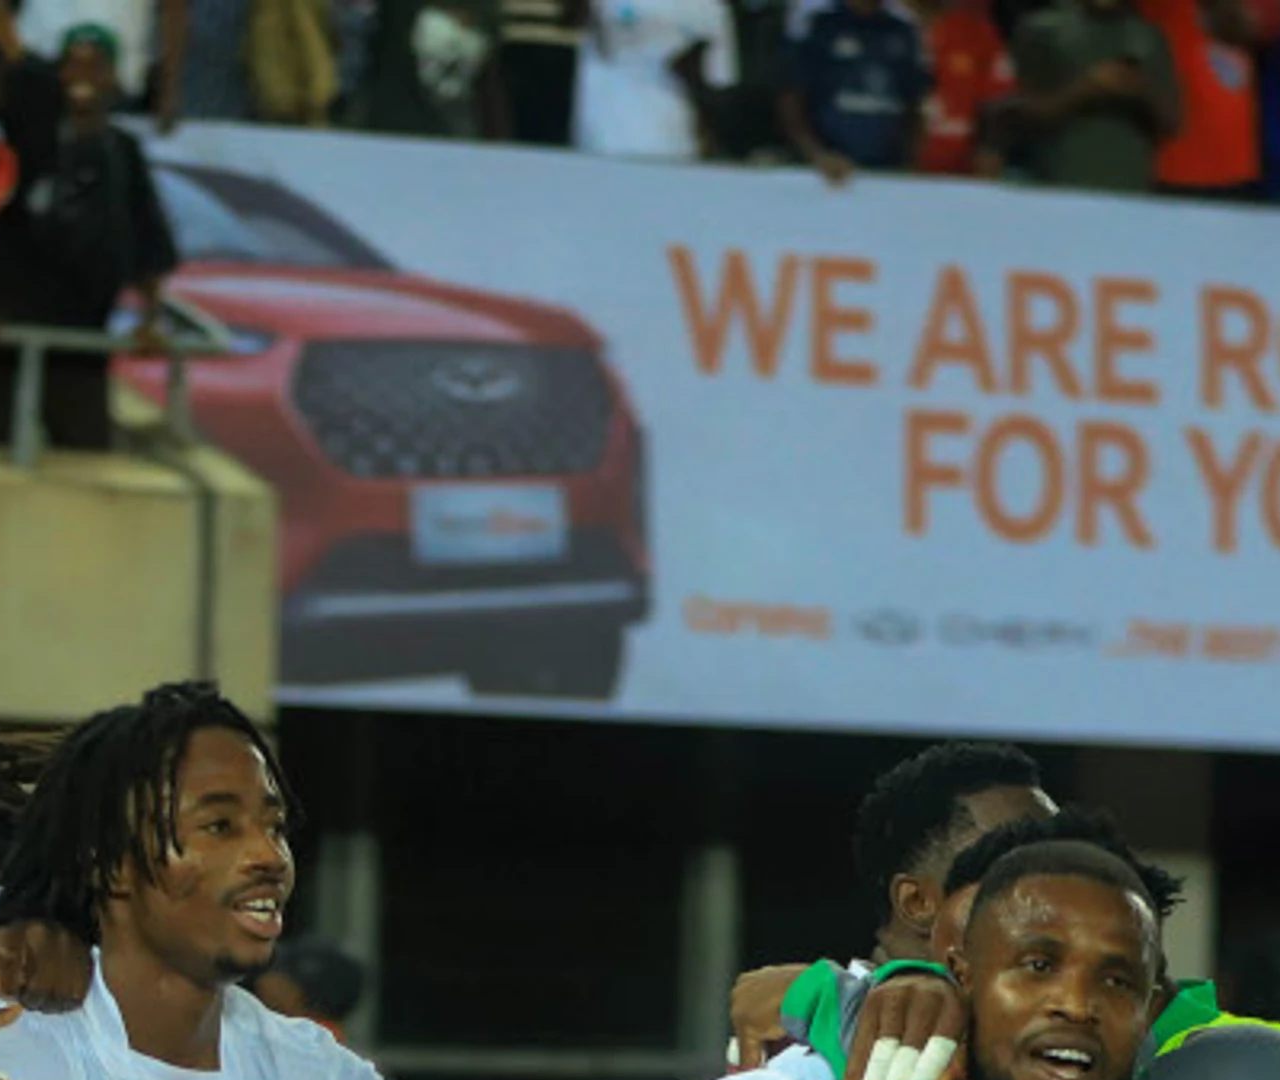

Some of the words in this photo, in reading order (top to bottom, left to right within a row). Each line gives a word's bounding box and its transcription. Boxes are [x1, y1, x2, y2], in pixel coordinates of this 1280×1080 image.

[666, 242, 878, 386] WE
[906, 264, 1159, 404] ARE
[902, 408, 1157, 550] FOR
